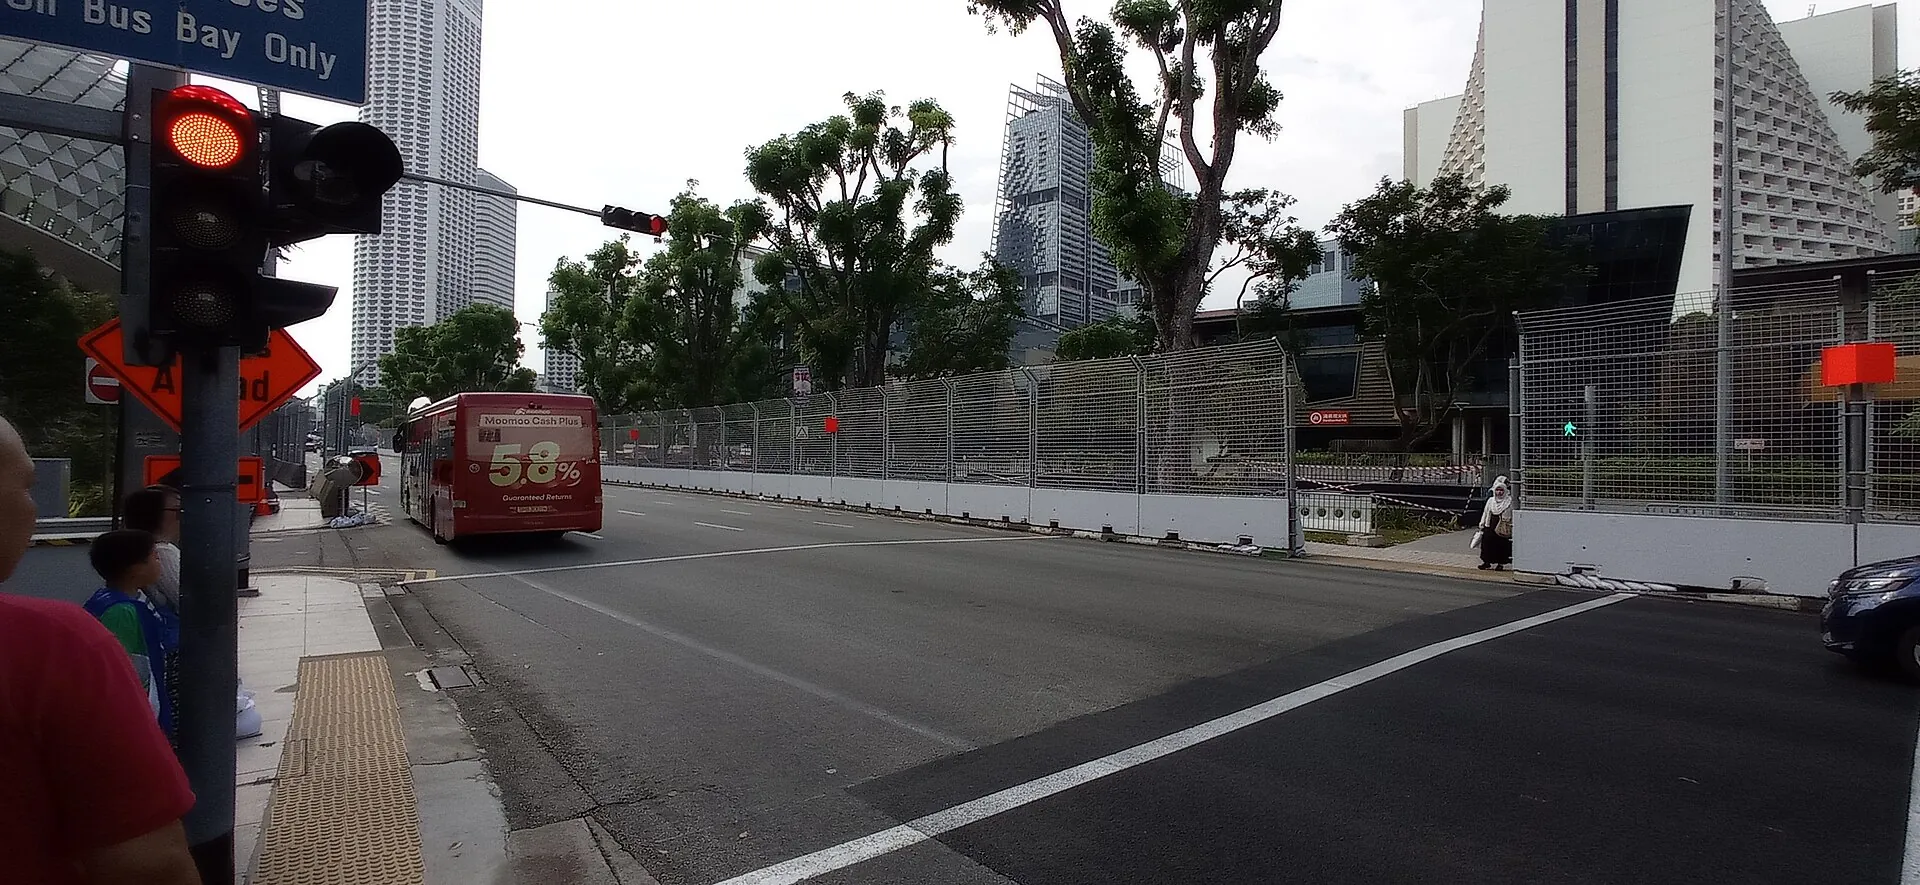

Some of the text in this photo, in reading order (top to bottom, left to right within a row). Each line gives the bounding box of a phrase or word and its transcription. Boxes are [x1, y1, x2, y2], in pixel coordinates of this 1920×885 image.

[84, 0, 151, 34] Bus
[177, 12, 240, 58] Bay
[265, 33, 336, 80] Only
[485, 416, 579, 425] Moomoo Cash Plus
